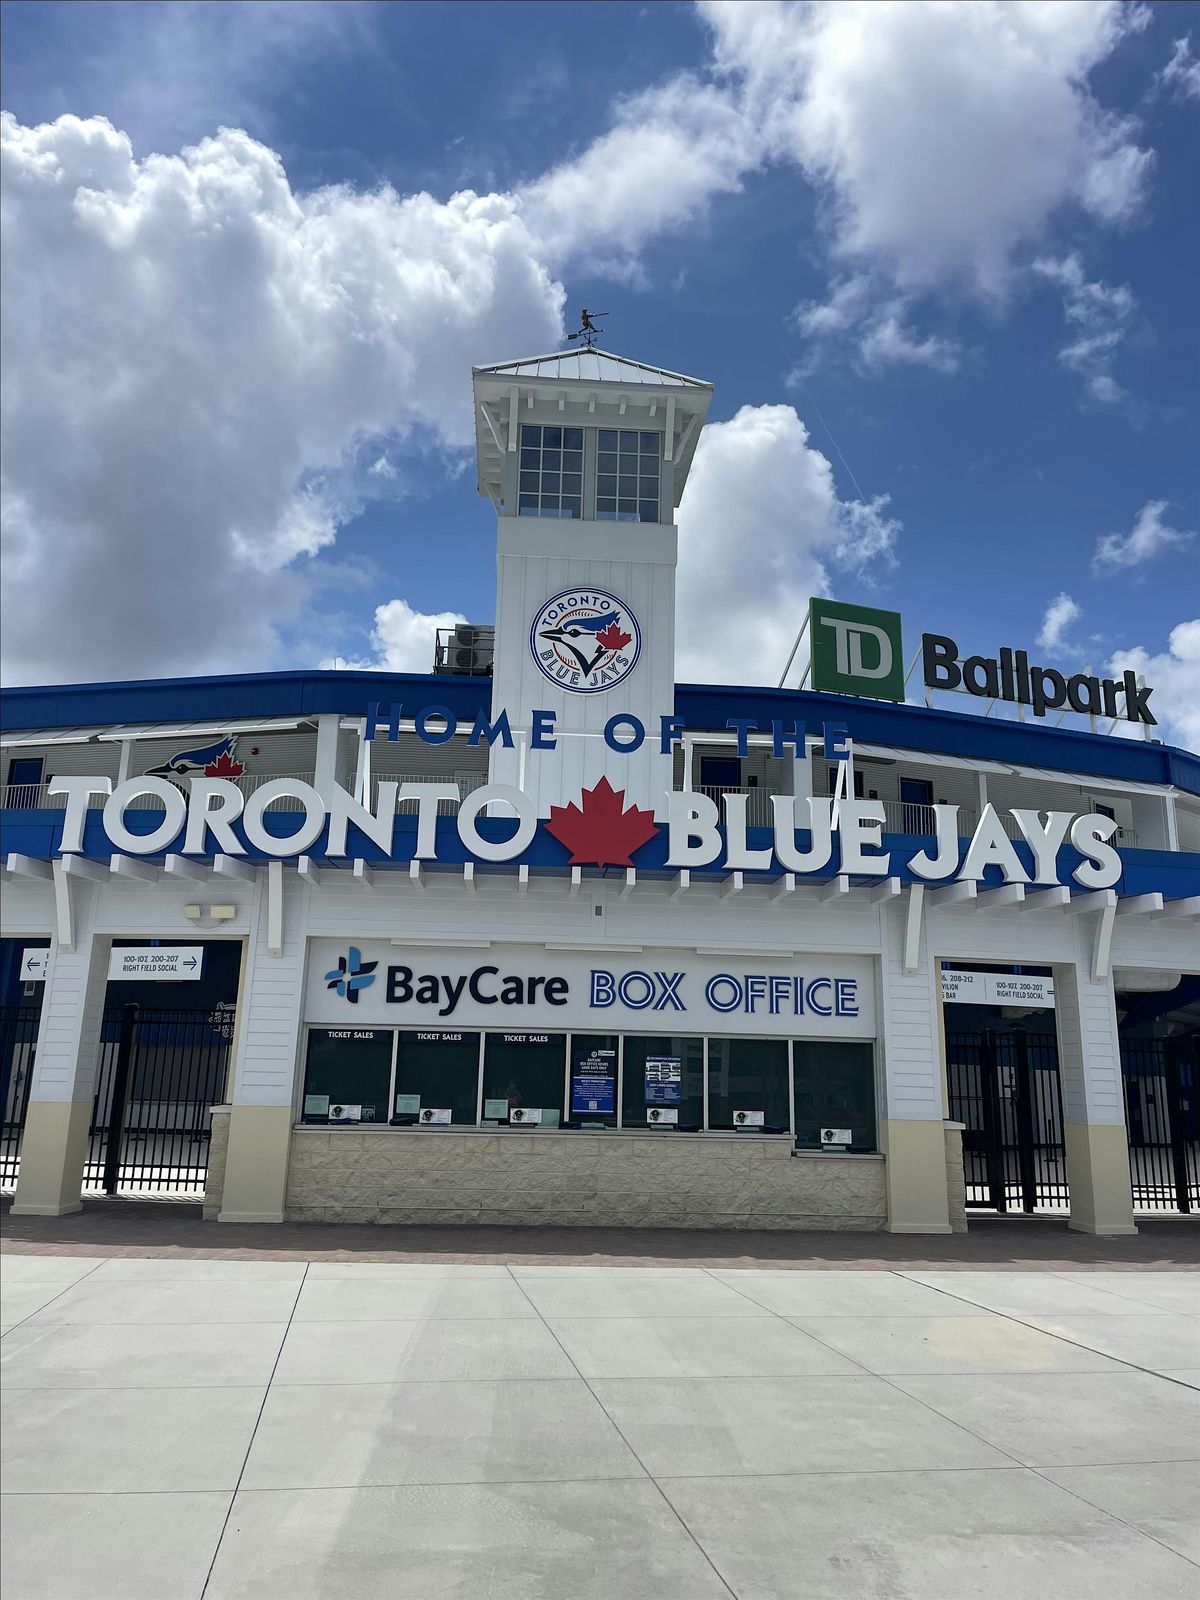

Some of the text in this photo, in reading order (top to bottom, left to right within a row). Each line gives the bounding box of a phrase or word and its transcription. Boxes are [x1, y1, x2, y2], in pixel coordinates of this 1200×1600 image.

[542, 596, 610, 626] TORONTO
[540, 649, 629, 687] BLUE JAYS
[820, 616, 1158, 725] TD Ballpark
[364, 701, 850, 760] HOME OF THE
[47, 775, 1122, 889] TORONTO BLUE JAYS
[151, 955, 179, 963] 200-207
[122, 964, 178, 972] RIGHT FIELD SOCIAL
[949, 974, 974, 983] 208-212
[385, 965, 859, 1017] BayCare BOX OFFICE
[1019, 983, 1043, 991] 200-207
[996, 990, 1044, 1000] RIGHT FIELD SOCIAL
[328, 1031, 374, 1039] TICKET SALES
[442, 1033, 462, 1041] SALES
[529, 1035, 549, 1043] SALES
